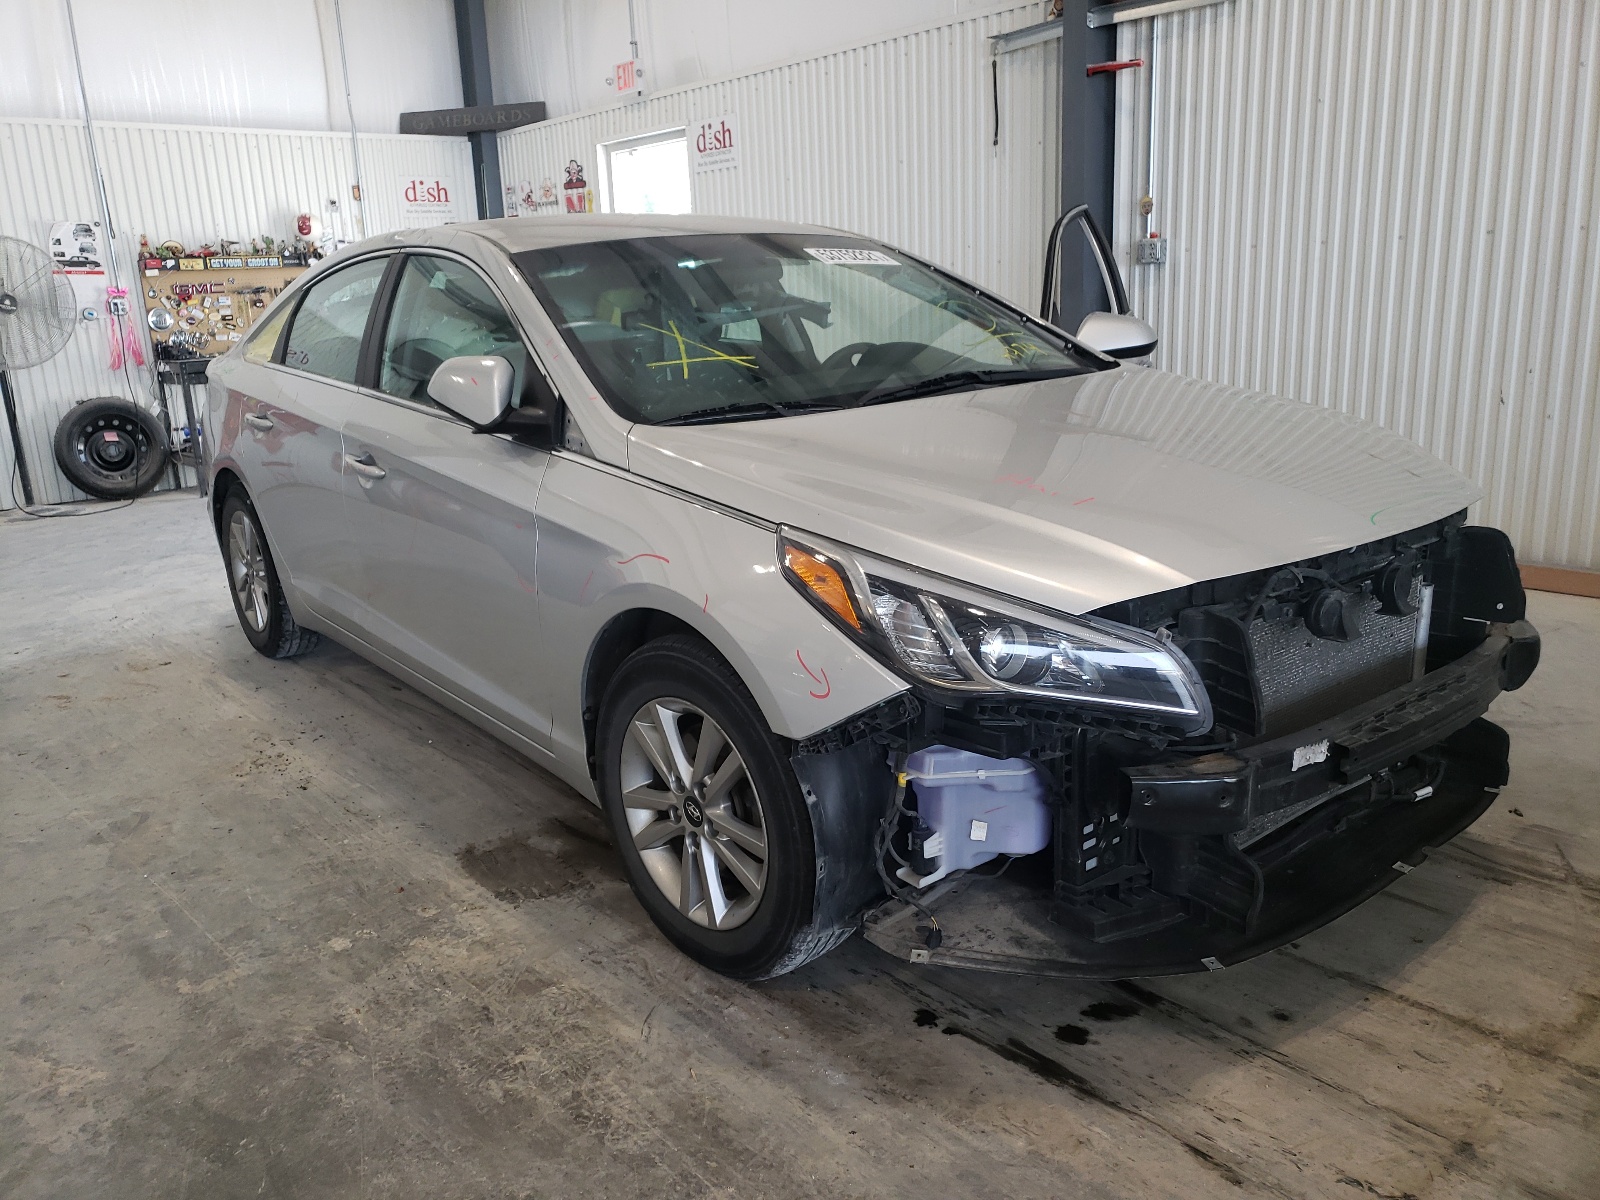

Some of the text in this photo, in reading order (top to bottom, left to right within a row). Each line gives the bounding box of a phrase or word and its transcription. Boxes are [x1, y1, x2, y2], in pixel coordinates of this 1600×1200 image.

[616, 60, 635, 91] EXIT
[412, 108, 532, 130] GAMEBOARDS
[697, 120, 734, 153] dish
[405, 180, 451, 202] dish
[210, 259, 223, 268] GET
[223, 258, 243, 267] YOUR
[269, 257, 279, 266] ON
[173, 281, 226, 295] GMC
